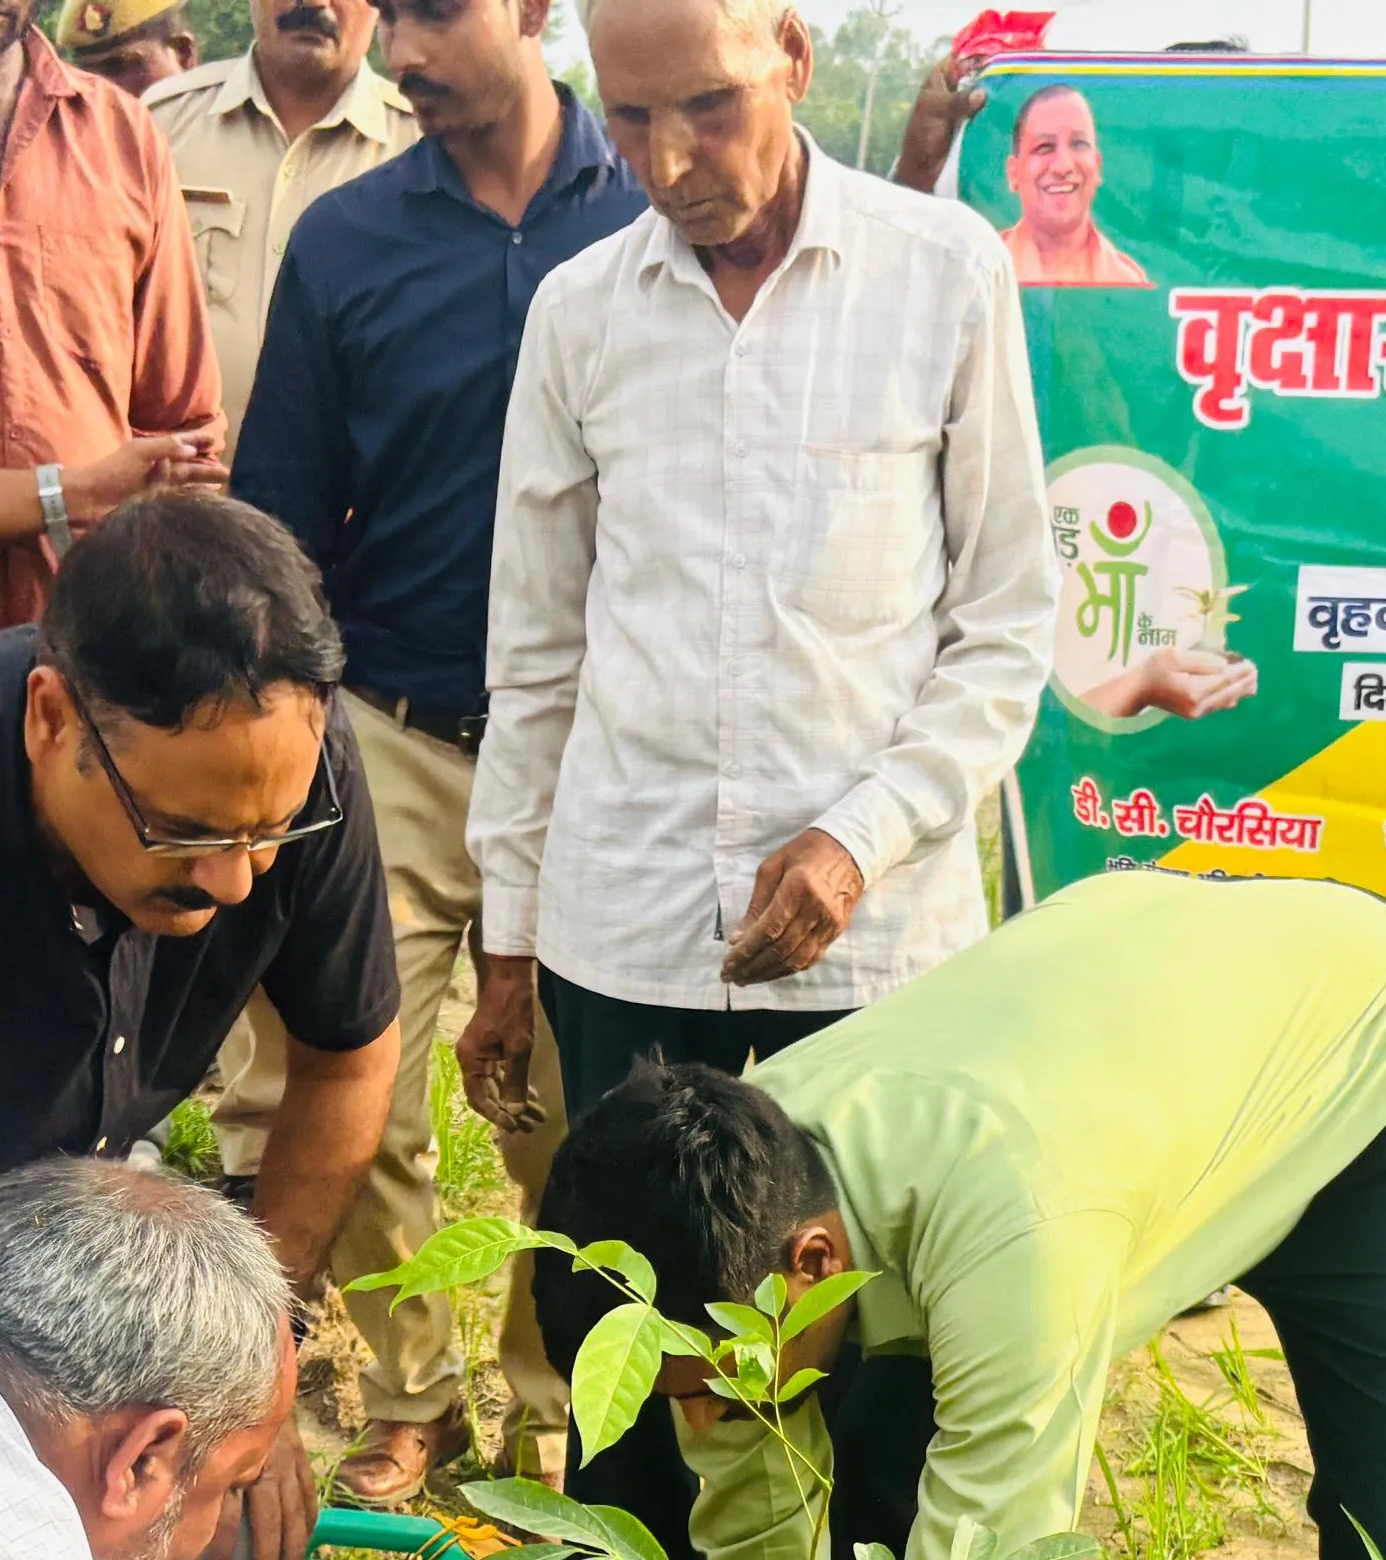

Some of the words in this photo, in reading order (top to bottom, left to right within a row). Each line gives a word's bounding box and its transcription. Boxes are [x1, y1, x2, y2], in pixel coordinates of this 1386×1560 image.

[1054, 506, 1080, 525] एक
[1137, 628, 1178, 647] नाम
[1072, 778, 1110, 829] डी.
[1112, 789, 1169, 837] सी.
[1174, 794, 1323, 852] चौरसिया
